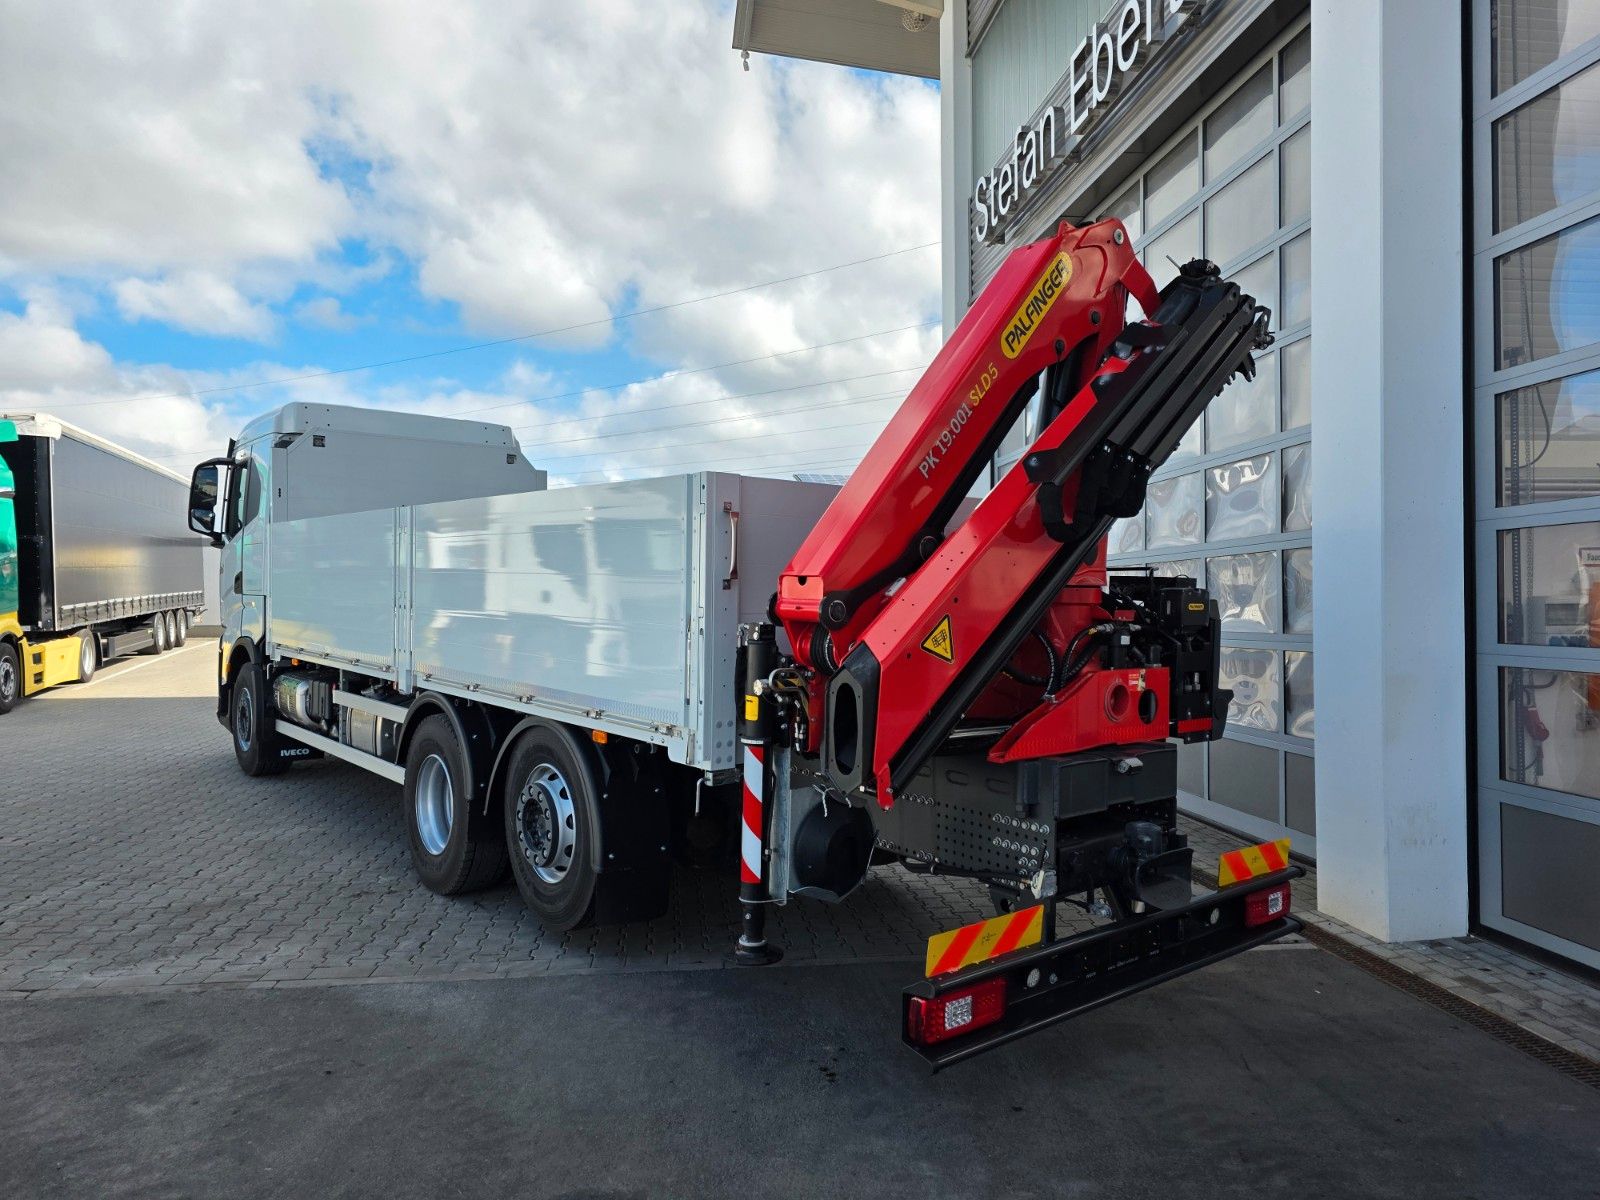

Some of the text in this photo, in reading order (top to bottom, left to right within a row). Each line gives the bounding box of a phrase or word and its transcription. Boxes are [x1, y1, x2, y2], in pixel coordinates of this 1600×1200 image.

[974, 105, 1055, 242] Stefan
[919, 449, 941, 479] PK
[935, 402, 973, 455] 19.001
[280, 748, 310, 757] IVECO
